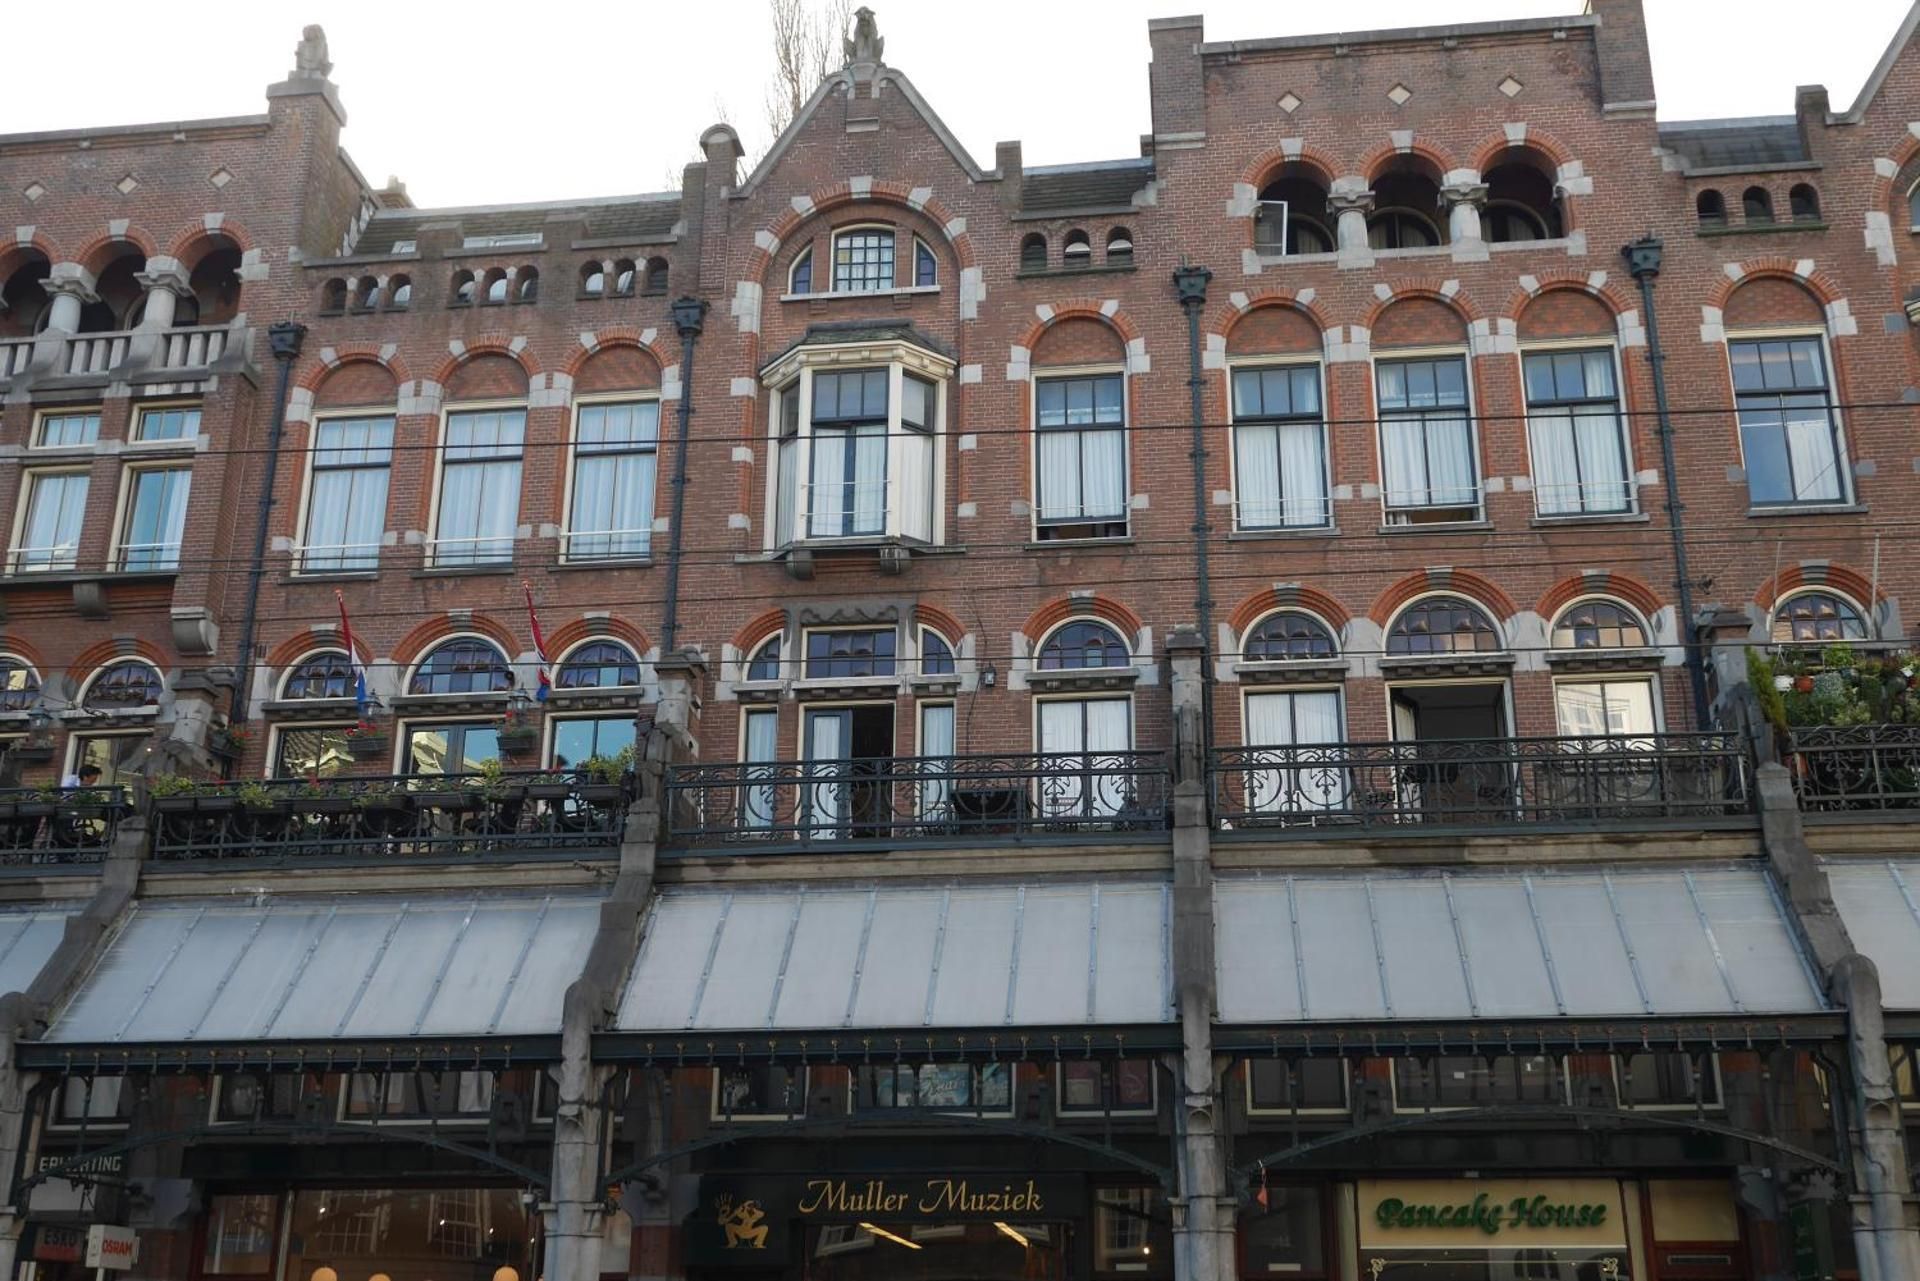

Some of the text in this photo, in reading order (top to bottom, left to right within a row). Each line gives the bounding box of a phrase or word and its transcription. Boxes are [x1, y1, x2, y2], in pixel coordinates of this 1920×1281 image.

[799, 1179, 1044, 1213] Muller Muziek
[1375, 1193, 1608, 1235] Pancake House
[102, 1239, 133, 1256] OSRAM
